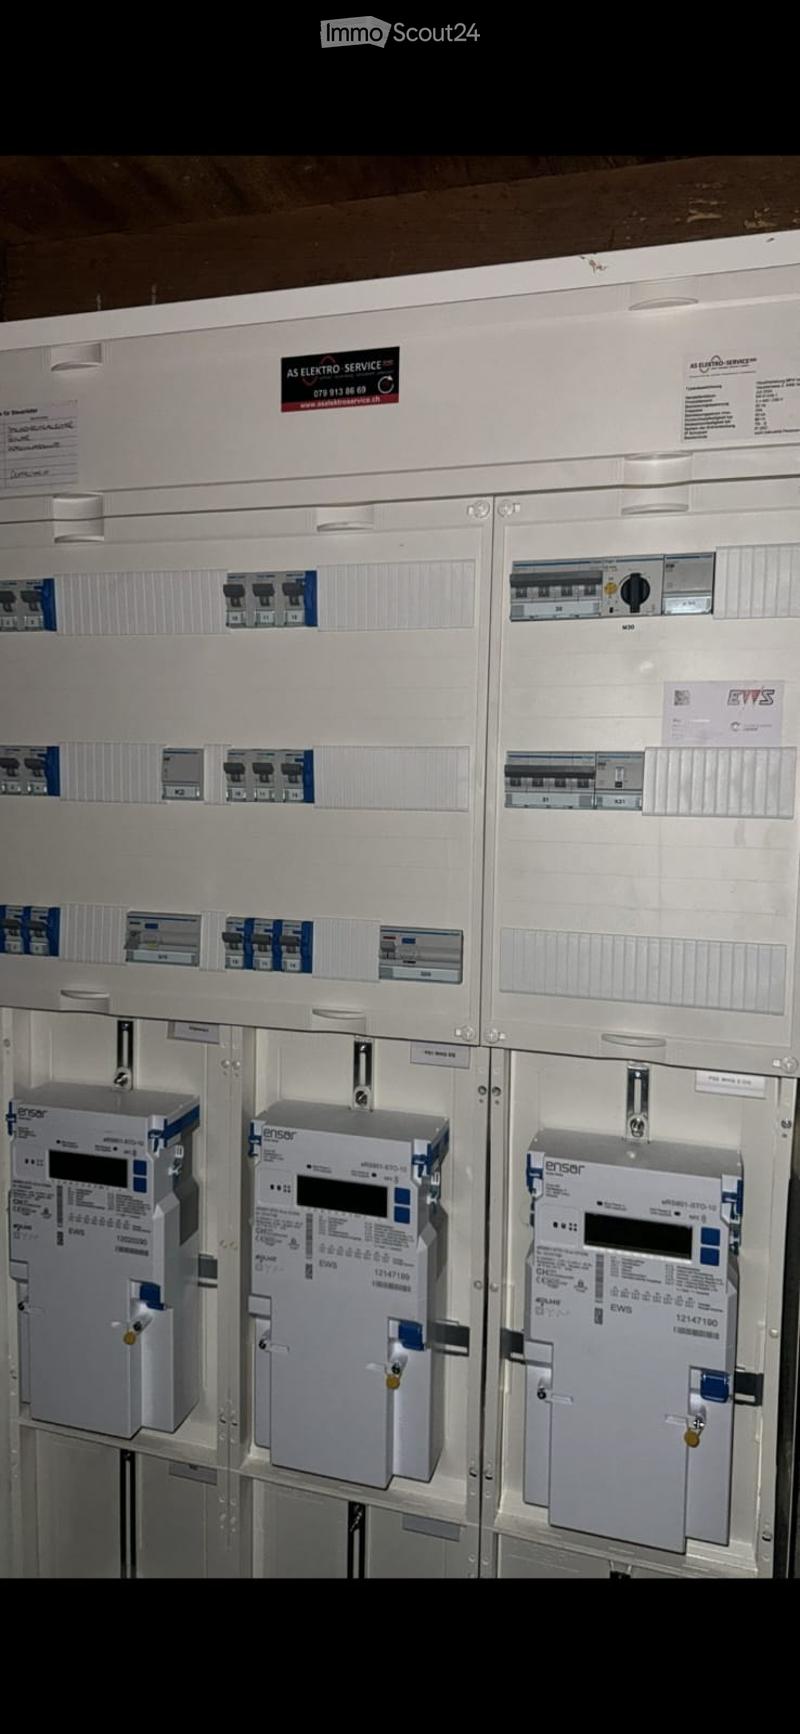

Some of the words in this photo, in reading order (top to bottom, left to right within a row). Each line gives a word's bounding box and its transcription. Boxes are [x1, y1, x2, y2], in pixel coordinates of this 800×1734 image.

[287, 368, 298, 378] AS
[314, 389, 327, 398] 079
[329, 388, 343, 396] 913
[727, 689, 776, 706] EWS
[610, 1304, 632, 1314] EWS
